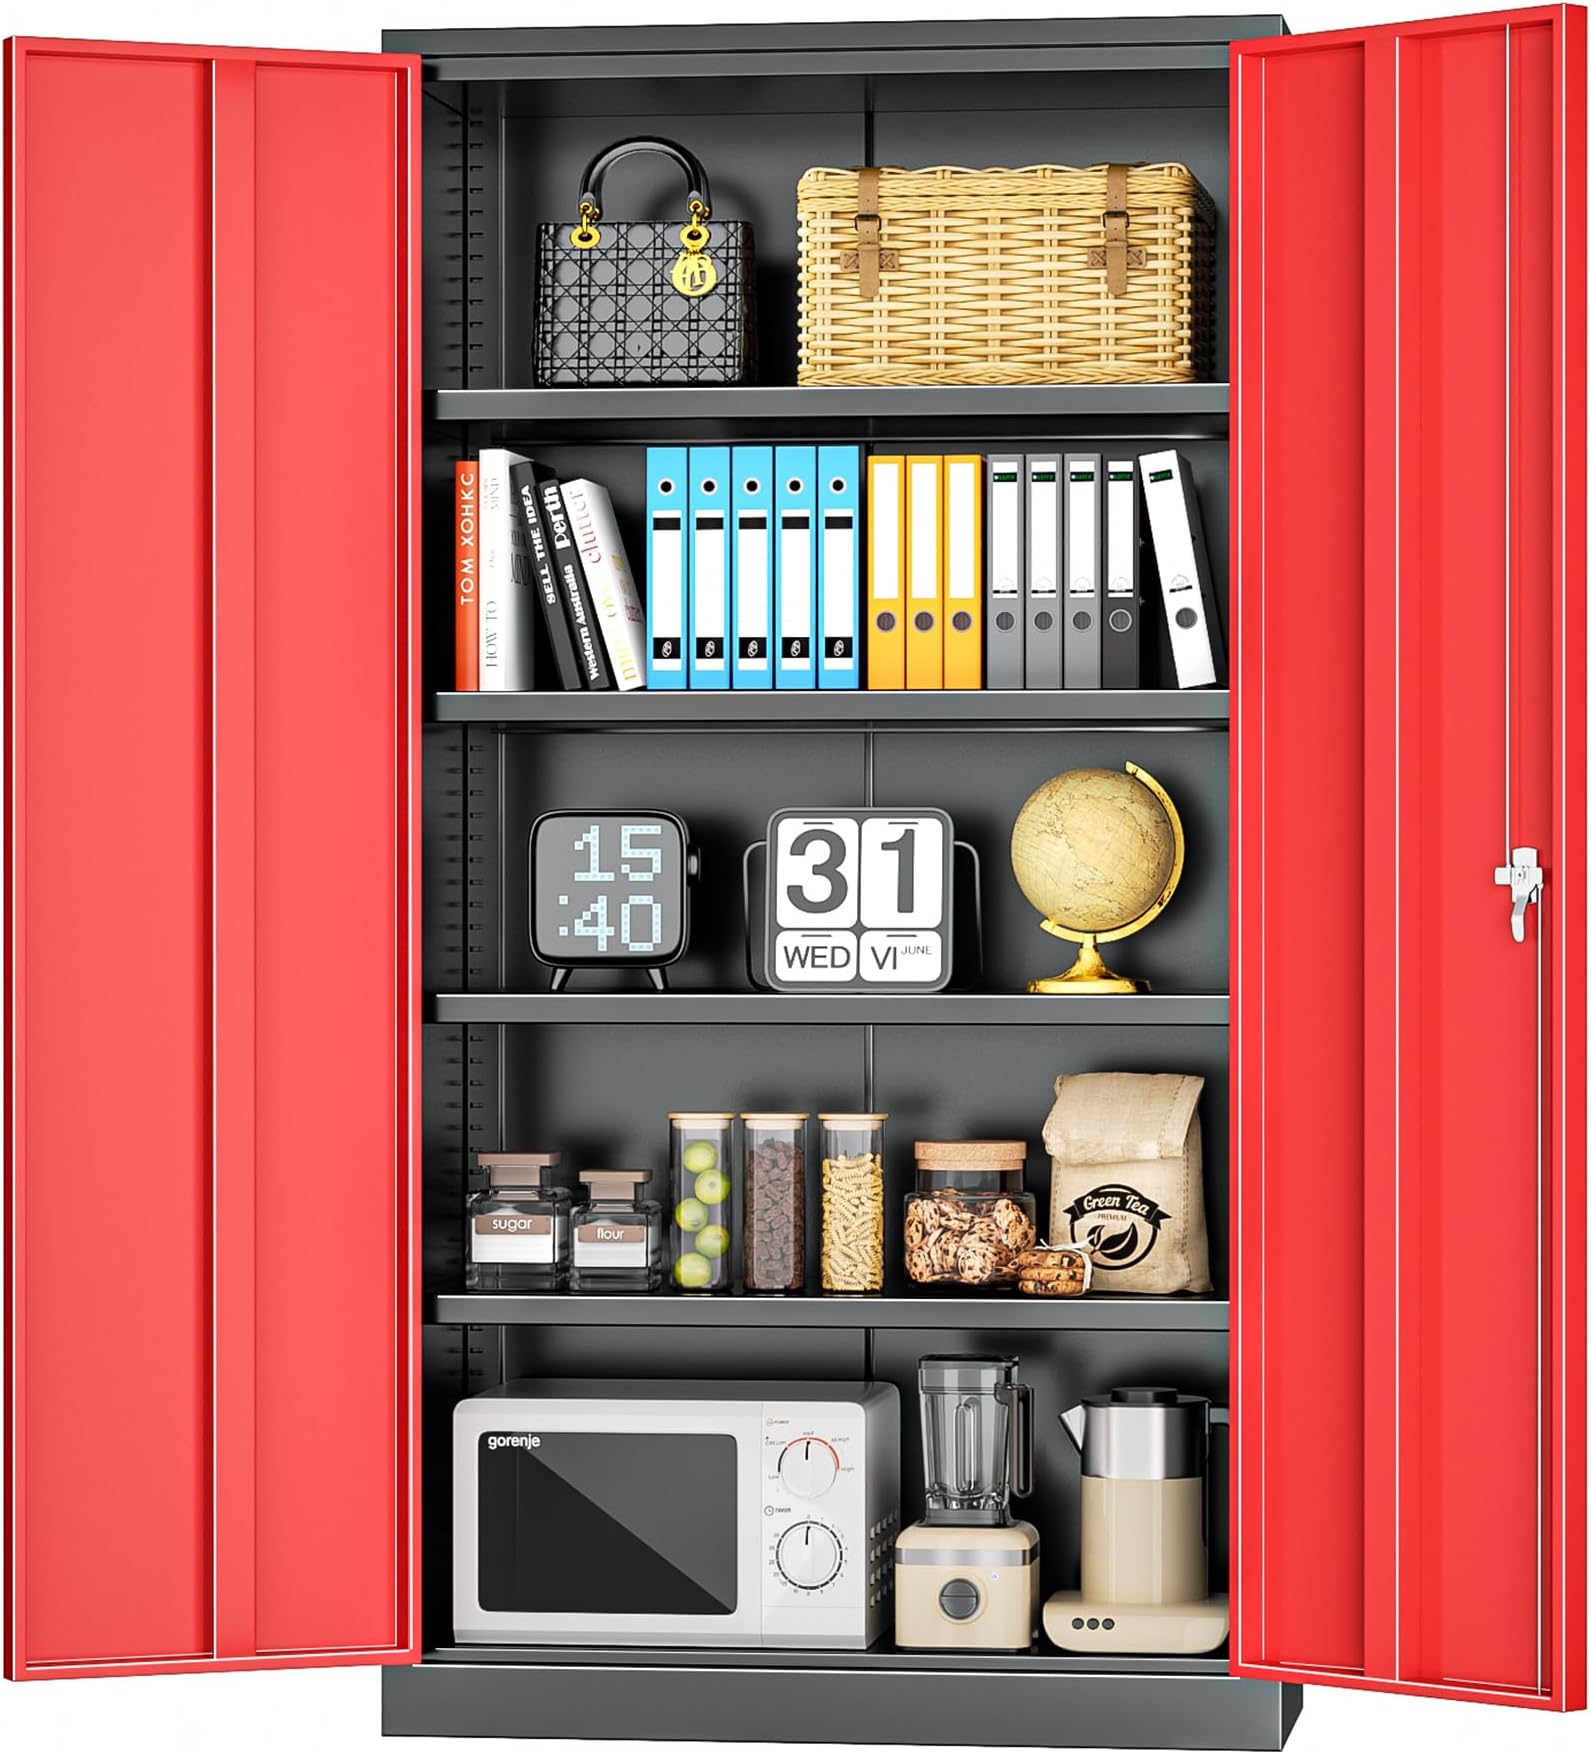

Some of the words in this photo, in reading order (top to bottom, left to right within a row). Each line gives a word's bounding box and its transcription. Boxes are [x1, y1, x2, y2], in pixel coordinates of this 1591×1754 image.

[521, 484, 537, 524] IDEA
[530, 527, 546, 562] THE
[569, 490, 601, 564] clutter
[540, 563, 556, 605] SELL
[563, 563, 587, 625] Australia
[486, 600, 498, 621] TO
[486, 629, 498, 667] HOW
[580, 626, 600, 681] Western
[574, 825, 662, 881] 15
[783, 945, 851, 969] WED
[870, 946, 897, 970] VI
[900, 945, 933, 955] JUNE
[1083, 1195, 1121, 1210] Green
[1125, 1194, 1151, 1216] Tea
[492, 1218, 533, 1233] sugar
[596, 1228, 625, 1240] flour
[487, 1433, 541, 1450] gorenje
